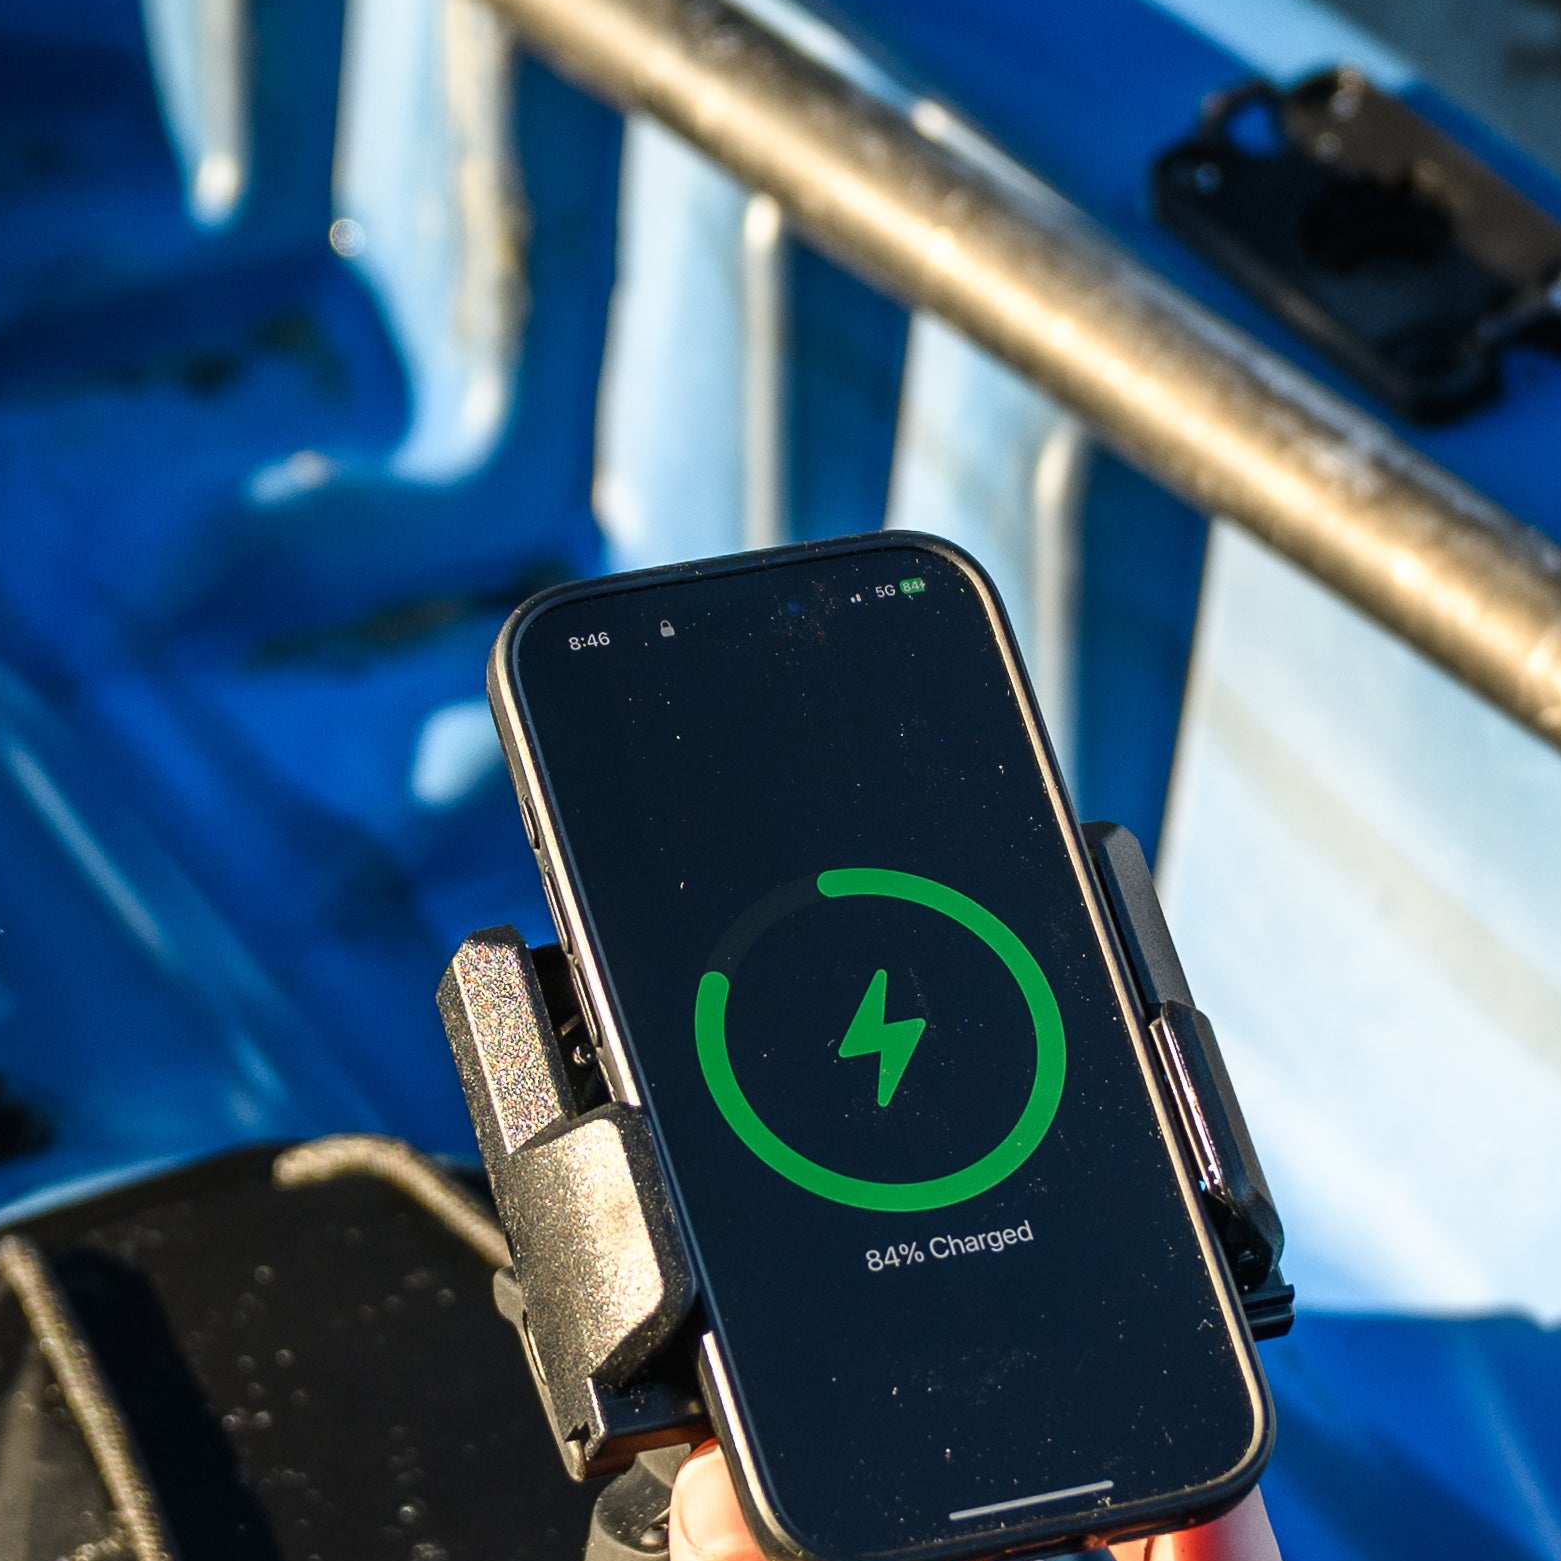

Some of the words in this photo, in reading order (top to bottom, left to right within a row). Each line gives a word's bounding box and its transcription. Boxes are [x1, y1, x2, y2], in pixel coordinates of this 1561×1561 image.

[875, 584, 896, 598] 5G
[568, 631, 611, 651] 8:46
[865, 1241, 925, 1272] 84%
[929, 1219, 1034, 1259] Charged
